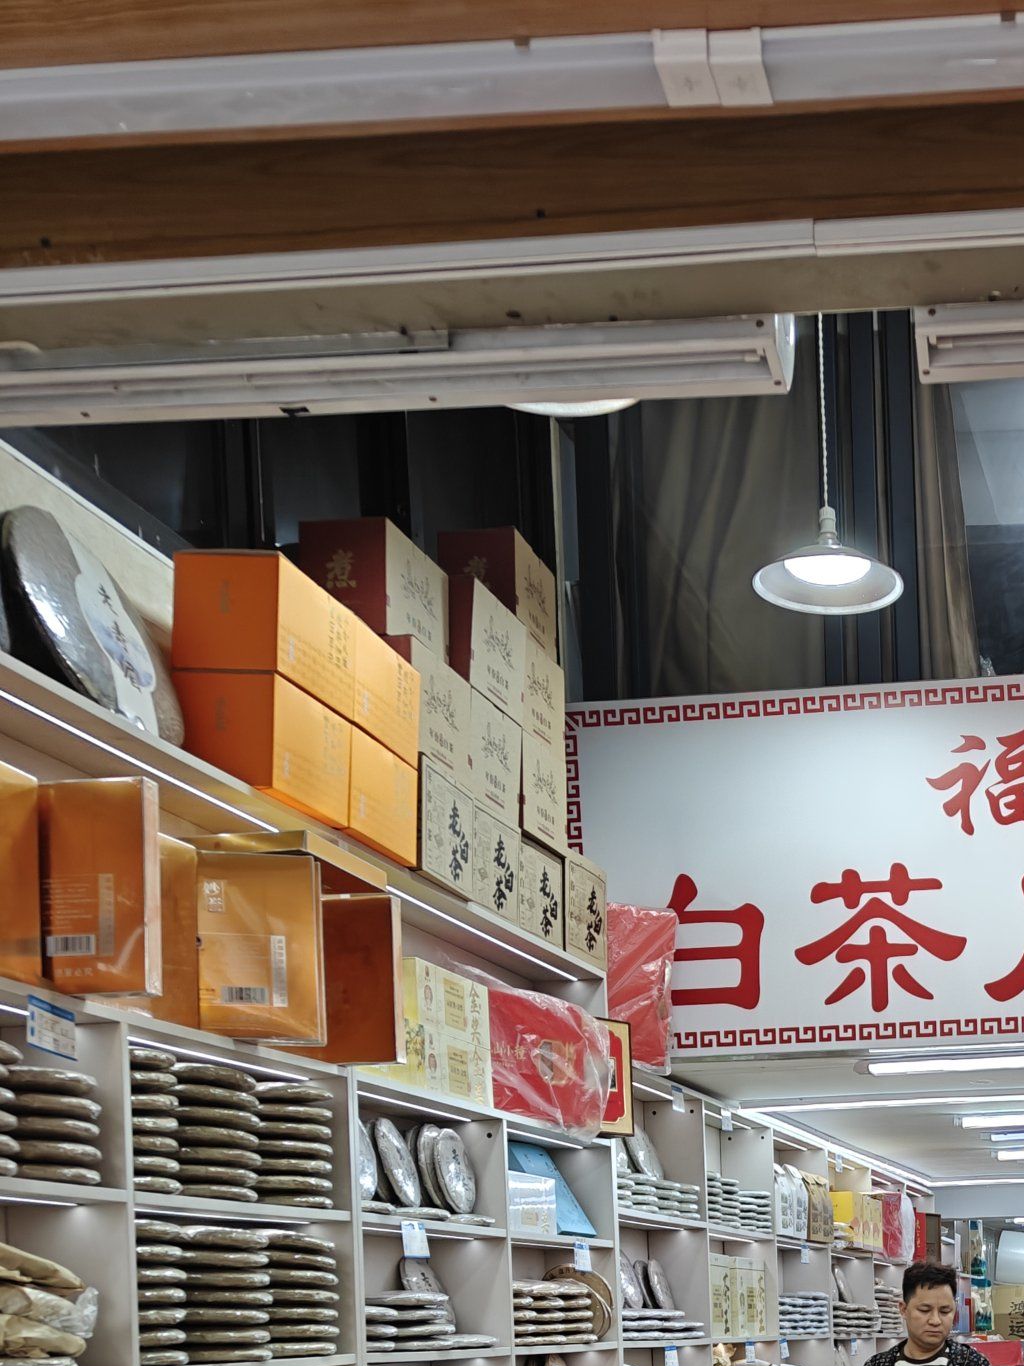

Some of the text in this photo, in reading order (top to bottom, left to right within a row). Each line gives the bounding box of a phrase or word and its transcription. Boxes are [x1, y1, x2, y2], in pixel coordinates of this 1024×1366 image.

[326, 549, 357, 589] 煮
[448, 799, 469, 882] 老白茶
[493, 833, 514, 912] 老白茶
[539, 865, 558, 938] 老白茶
[584, 884, 602, 953] 老白茶
